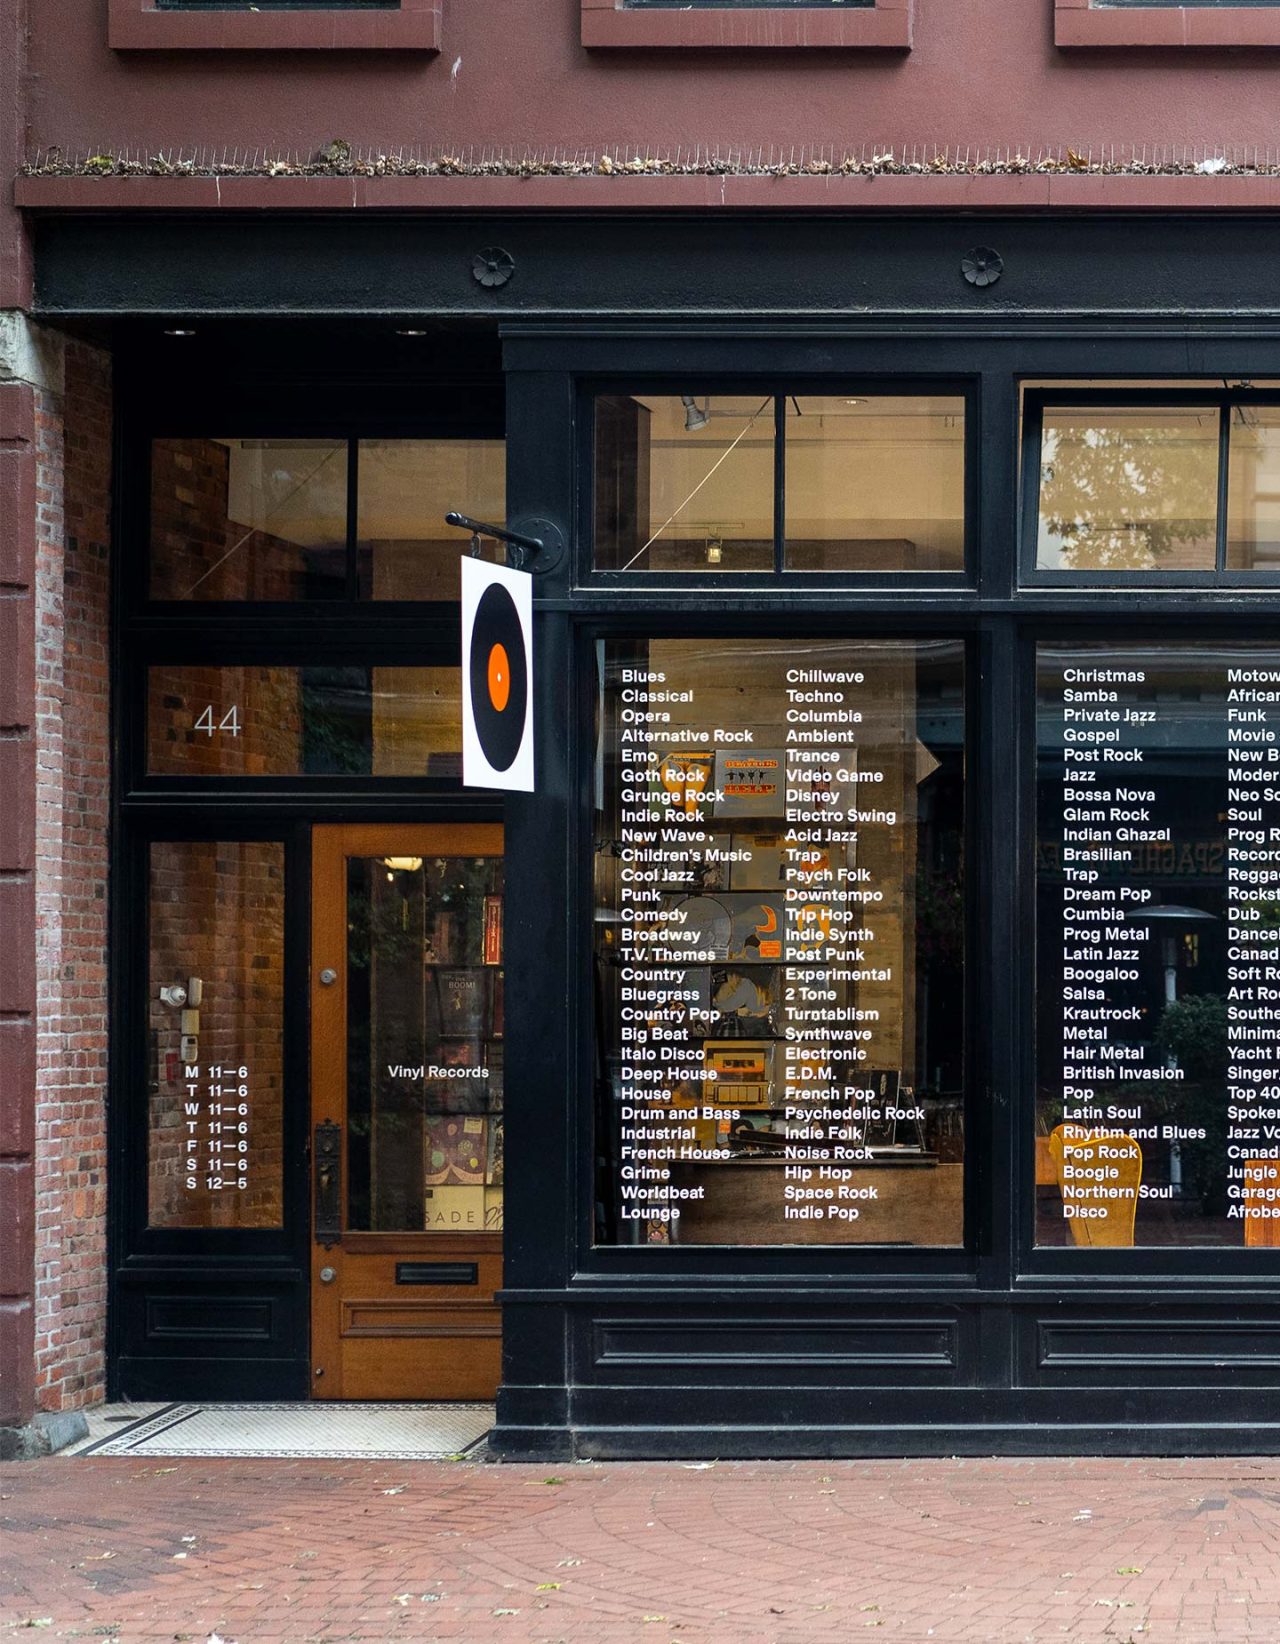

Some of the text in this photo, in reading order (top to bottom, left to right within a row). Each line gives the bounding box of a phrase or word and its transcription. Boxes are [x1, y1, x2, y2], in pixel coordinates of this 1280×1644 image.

[622, 669, 666, 683] Blues
[786, 669, 864, 683] Chillwave
[1063, 668, 1145, 682] Christmas
[785, 689, 844, 703] Techno
[194, 705, 242, 737] 44
[621, 708, 671, 725] Opera
[1064, 708, 1156, 722] Private Jazz
[785, 729, 854, 743] Ambient
[1228, 728, 1276, 742] Movie
[621, 748, 658, 763] Emo
[786, 768, 884, 783] Video Game
[621, 788, 725, 805] Grunge Rock
[724, 784, 776, 795] HELP!
[1064, 788, 1155, 801] Bossa Nova
[1227, 808, 1262, 821] Soul
[621, 828, 705, 842] New Wave
[1064, 827, 1170, 841] Indian Ghazal
[785, 848, 821, 864] Trap
[621, 868, 695, 882] Cool Jazz
[1062, 867, 1099, 884] Trap
[786, 888, 883, 904] Downtempo
[620, 907, 688, 924] Comedy
[1063, 907, 1125, 921] Cumbia
[785, 927, 874, 944] Indie Synth
[620, 947, 716, 962] T.V. Themes
[1063, 947, 1139, 960] Latin Jazz
[785, 967, 891, 984] Experimental
[1227, 966, 1261, 980] Soft
[621, 987, 700, 1004] Bluegrass
[1063, 986, 1105, 1000] Salsa
[784, 1007, 879, 1021] Turntablism
[621, 1027, 689, 1044] Big Beat
[1063, 1026, 1107, 1040] Metal
[785, 1046, 867, 1060] Electronic
[1227, 1046, 1272, 1060] Yacht
[185, 1065, 199, 1078] M
[388, 1065, 489, 1081] Vinyl Records
[621, 1066, 718, 1083] Deep House
[1063, 1066, 1184, 1080] British Invasion
[186, 1084, 198, 1097] T
[785, 1086, 875, 1103] French Pop
[1227, 1086, 1280, 1102] Top 40
[184, 1102, 200, 1116] W
[621, 1106, 741, 1120] Drum and Bass
[1063, 1105, 1141, 1119] Latin Soul
[186, 1121, 198, 1134] T
[785, 1126, 862, 1140] Indie Folk
[187, 1139, 198, 1152] F
[621, 1146, 730, 1160] French House
[1063, 1145, 1138, 1161] Pop Rock
[186, 1158, 197, 1171] S
[785, 1165, 853, 1182] Hip Hop
[1227, 1165, 1278, 1182] Jungle
[186, 1176, 197, 1189] S
[621, 1185, 705, 1200] Worldbeat
[1063, 1184, 1173, 1199] Northern Soul
[425, 1211, 475, 1224] SADE
[784, 1205, 859, 1222] Indie Pop
